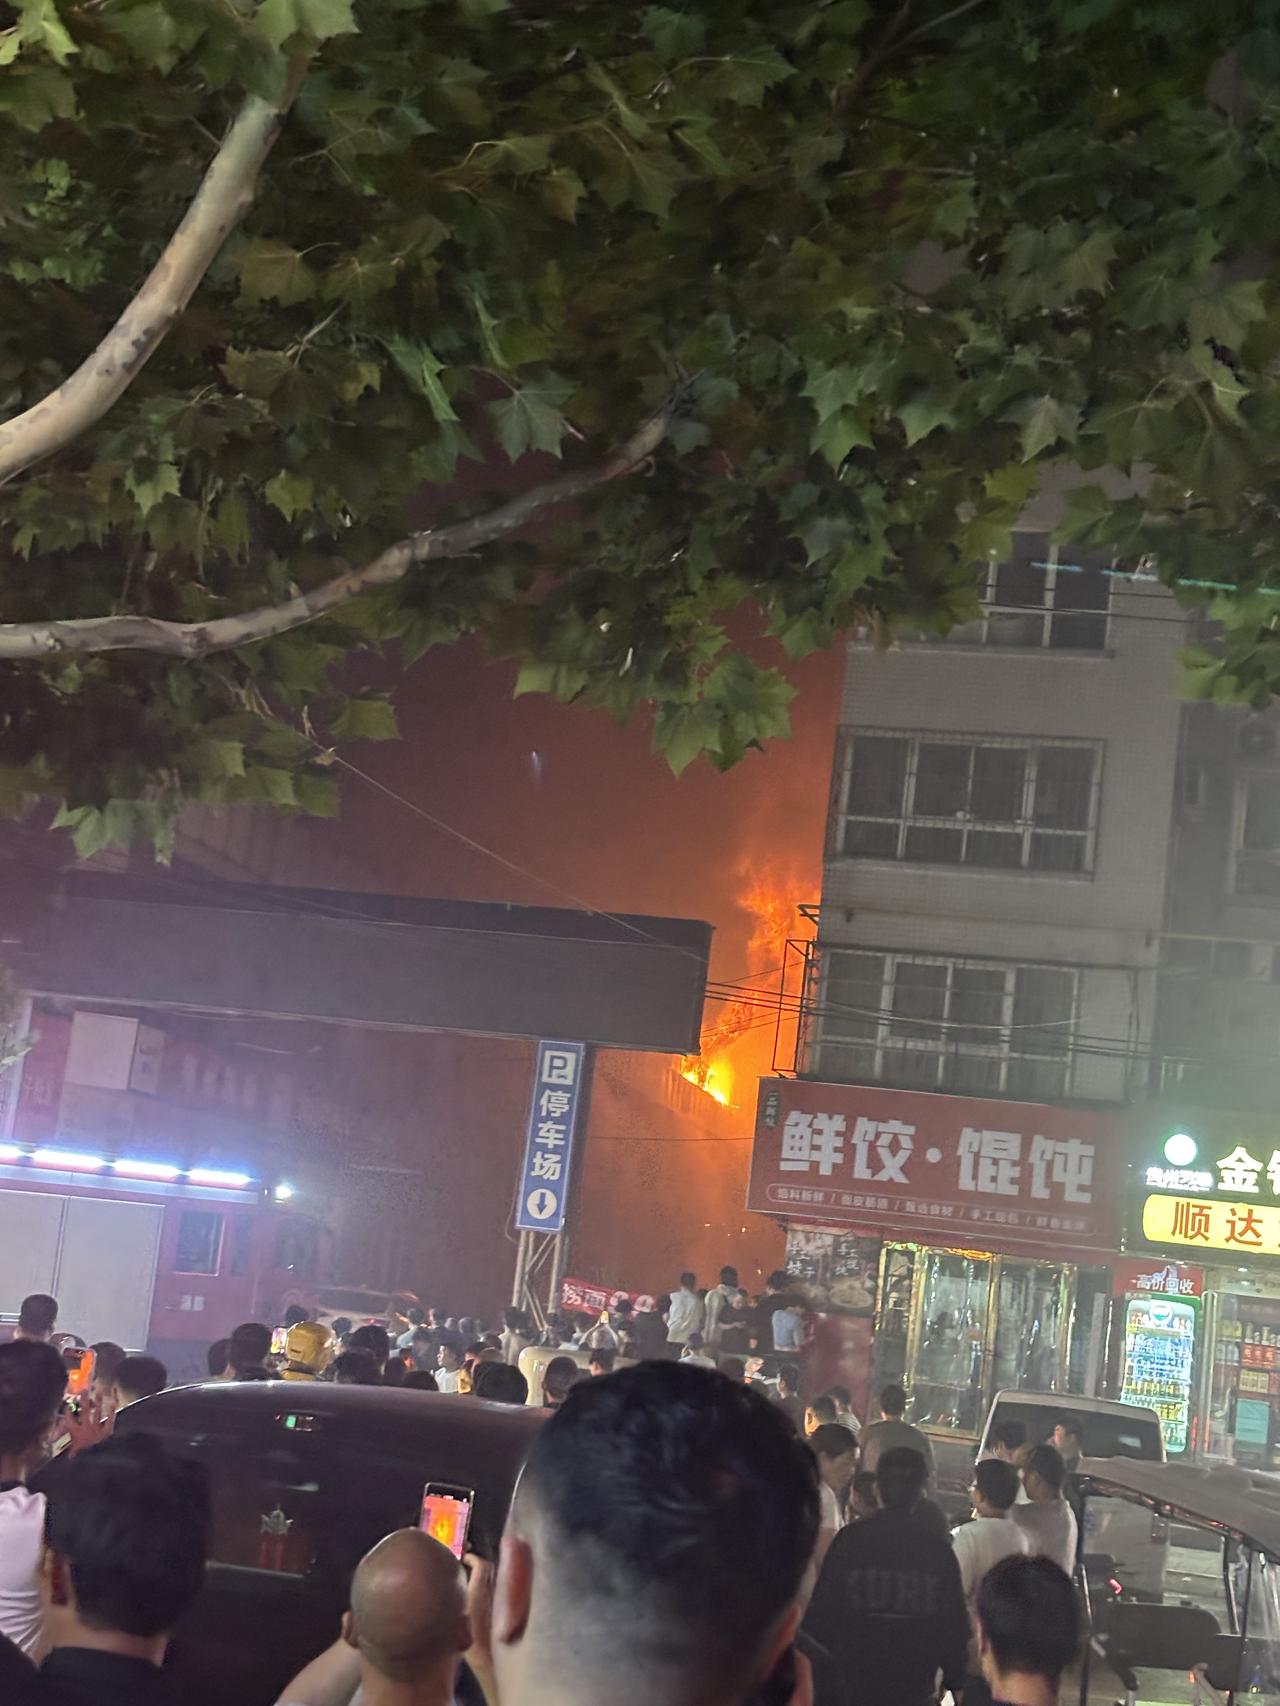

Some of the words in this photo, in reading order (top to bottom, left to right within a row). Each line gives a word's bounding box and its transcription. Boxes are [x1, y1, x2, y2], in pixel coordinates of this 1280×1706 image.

[530, 1089, 571, 1181] 停车场
[1171, 1201, 1280, 1248] 顺达
[1136, 1274, 1195, 1294] 高价回收
